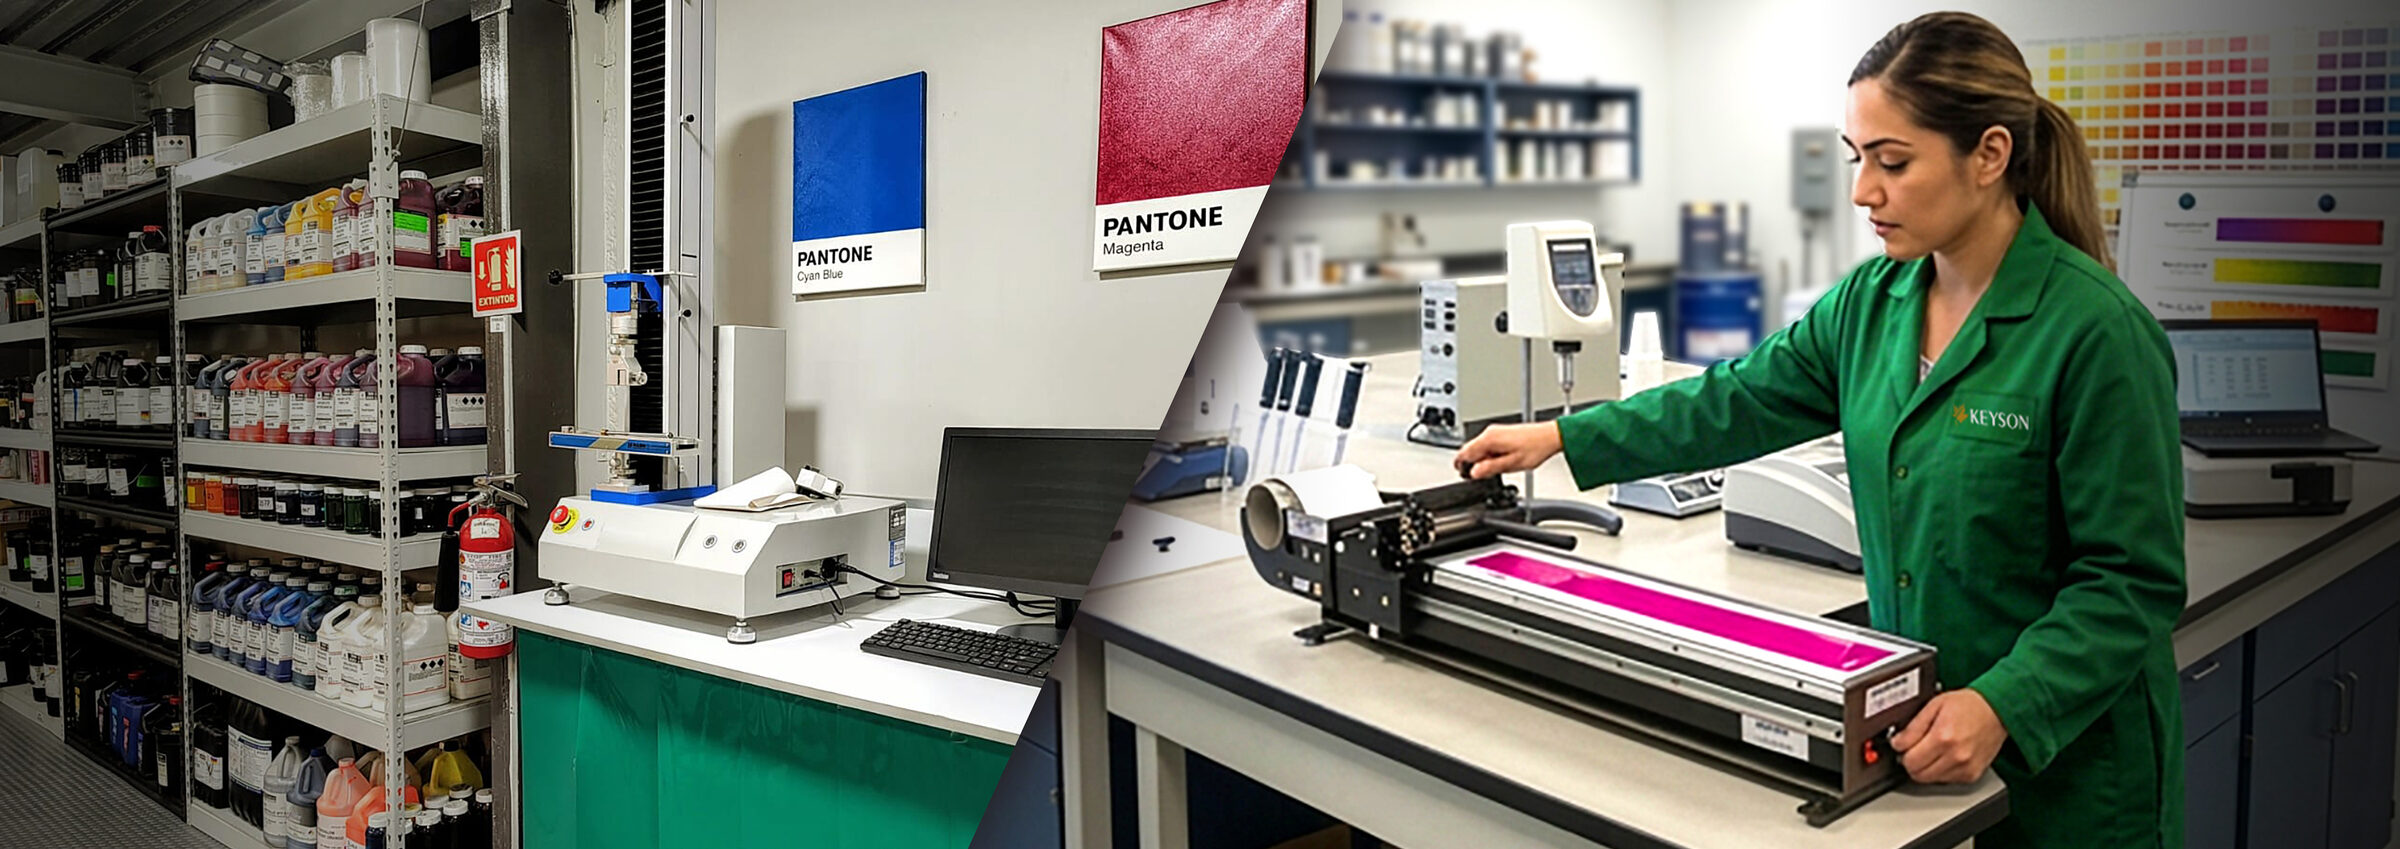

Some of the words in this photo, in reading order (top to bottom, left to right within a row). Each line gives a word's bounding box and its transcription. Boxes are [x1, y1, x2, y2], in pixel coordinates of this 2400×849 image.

[1103, 206, 1223, 237] PANTONE
[797, 245, 873, 267] PANTONE
[1103, 240, 1164, 256] Magenta
[797, 271, 820, 283] Cyan
[823, 269, 843, 279] Blue
[479, 294, 515, 306] EXTINTOR
[1969, 408, 2030, 431] KEYSON
